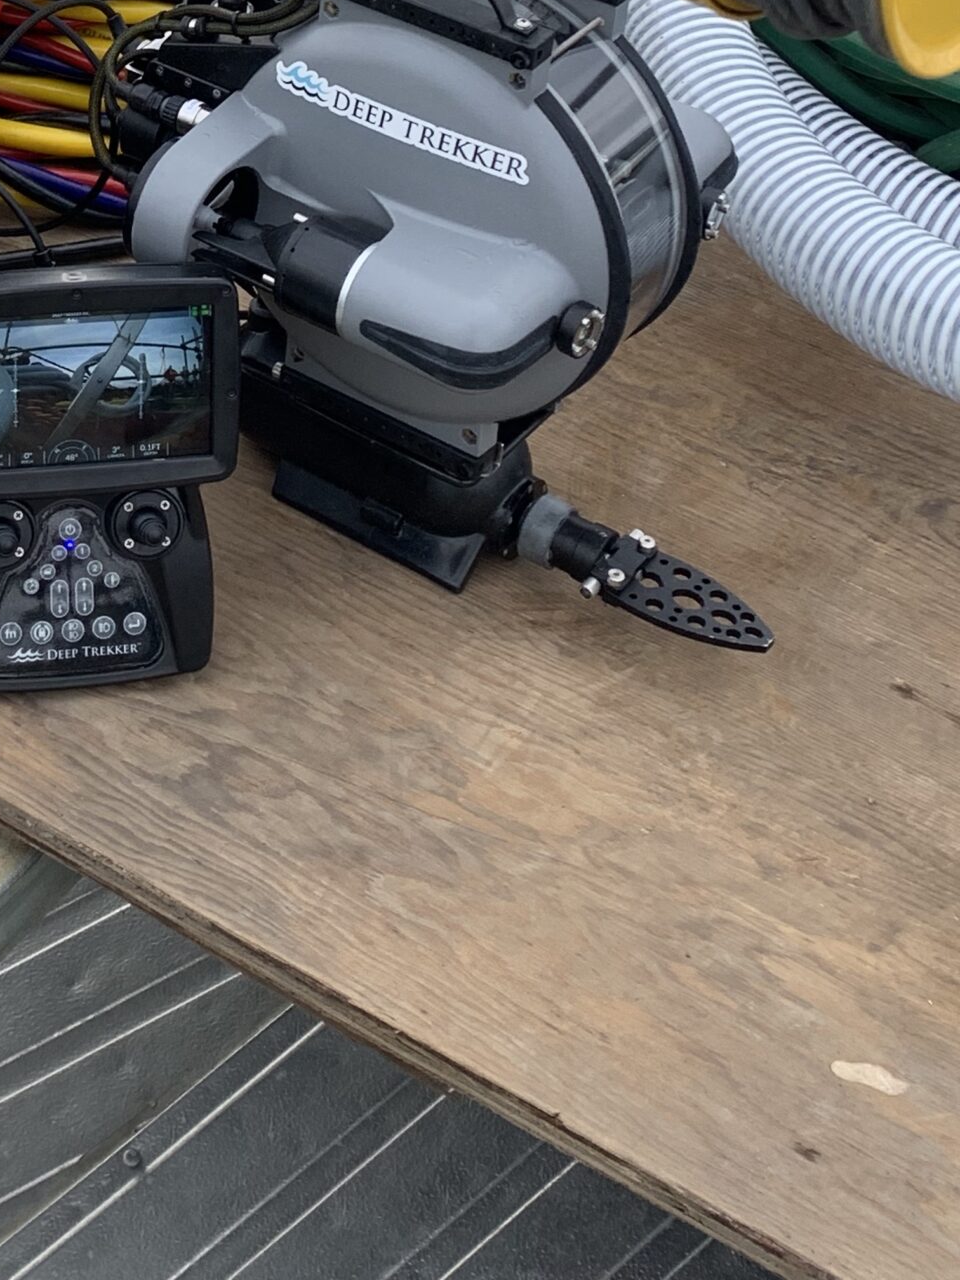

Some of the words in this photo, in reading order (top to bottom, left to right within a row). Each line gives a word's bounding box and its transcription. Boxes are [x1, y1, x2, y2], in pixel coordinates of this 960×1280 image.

[332, 90, 394, 129] DEEP
[402, 118, 524, 179] TREKKER
[4, 628, 17, 640] fn
[47, 647, 79, 661] DEEP
[82, 643, 139, 658] TREKKER
